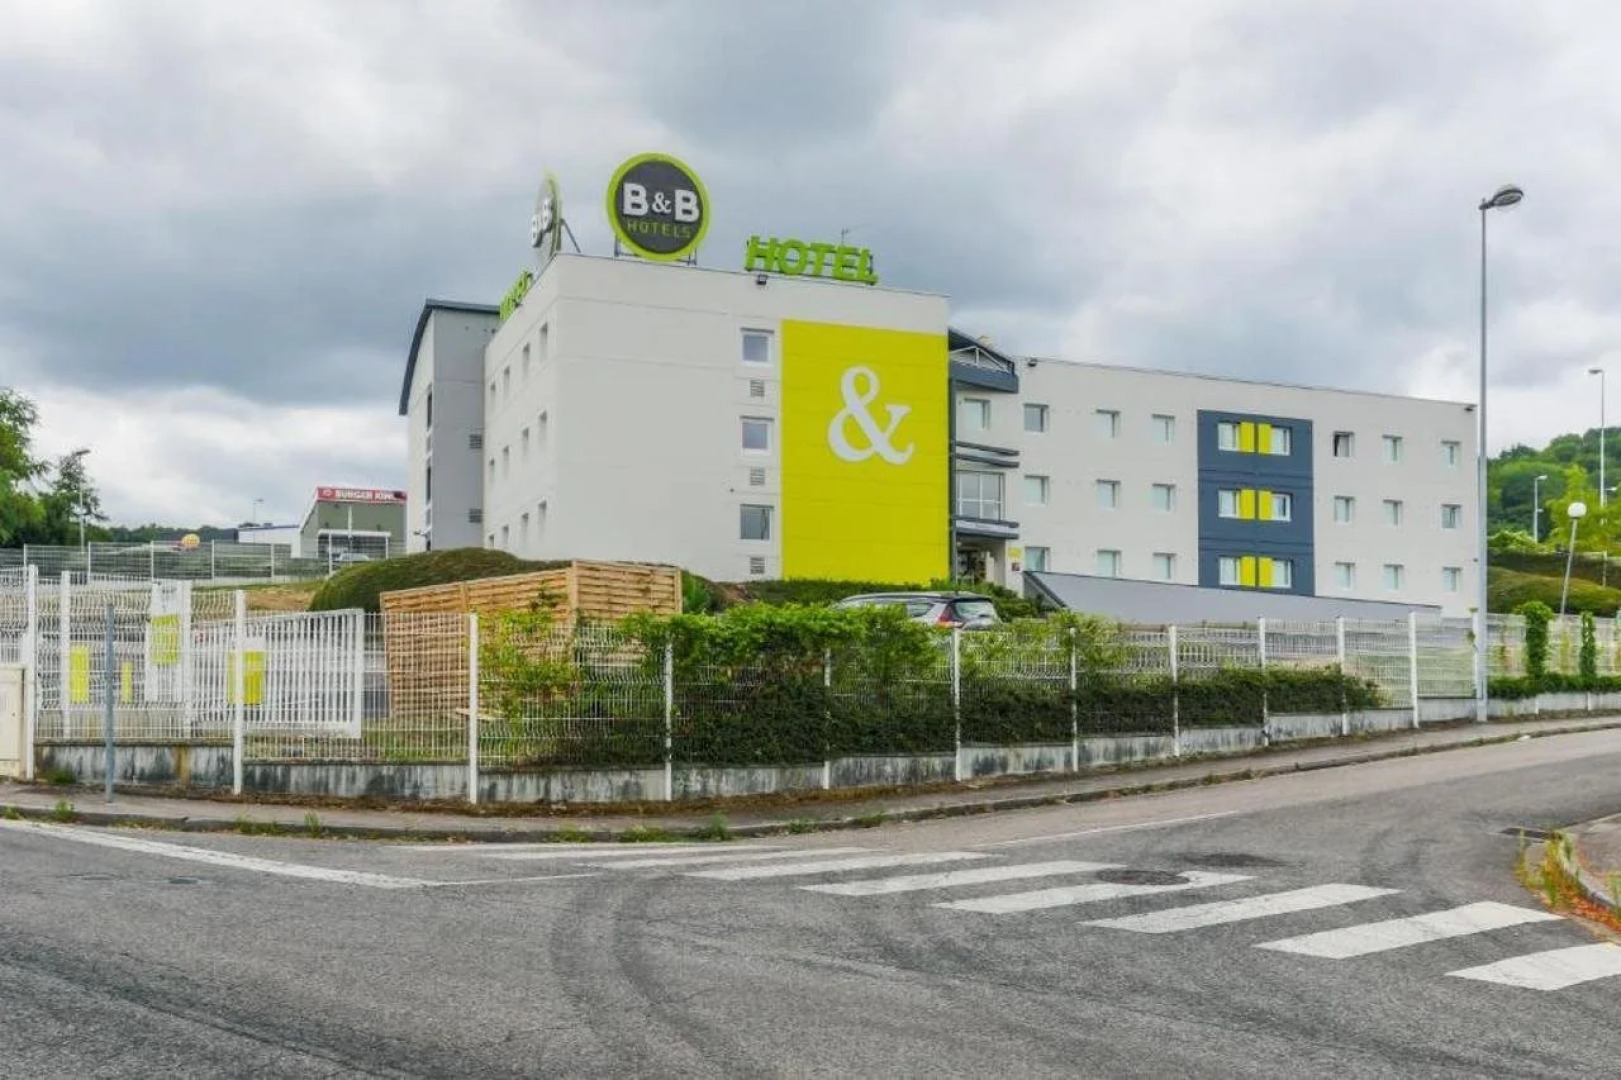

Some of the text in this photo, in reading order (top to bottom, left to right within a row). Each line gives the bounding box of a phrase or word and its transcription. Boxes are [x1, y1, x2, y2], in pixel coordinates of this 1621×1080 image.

[623, 183, 699, 222] B&B
[627, 219, 692, 239] HOTELS
[745, 235, 878, 285] HOTEL
[827, 365, 914, 465] &
[335, 488, 373, 500] BURGER
